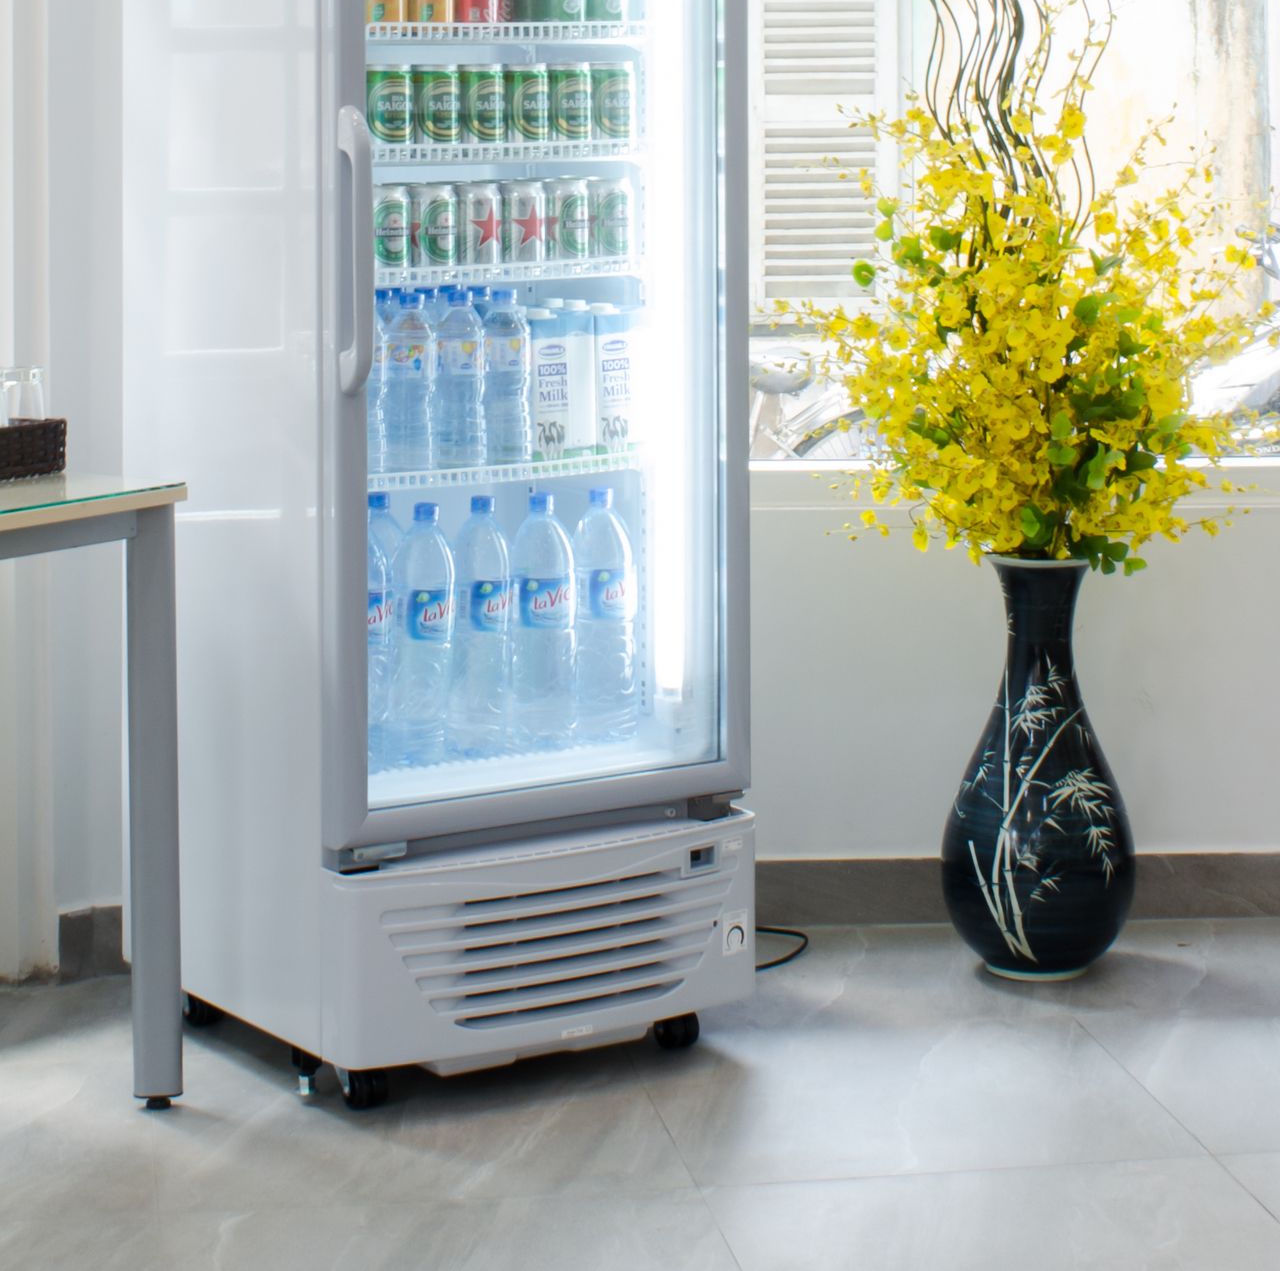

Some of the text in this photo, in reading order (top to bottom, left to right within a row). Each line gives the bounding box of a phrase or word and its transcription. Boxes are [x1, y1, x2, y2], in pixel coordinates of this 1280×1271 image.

[539, 364, 567, 376] 100%
[603, 359, 629, 371] 100%
[538, 378, 567, 389] Fresh
[539, 391, 568, 403] Milk
[603, 386, 630, 398] Milk
